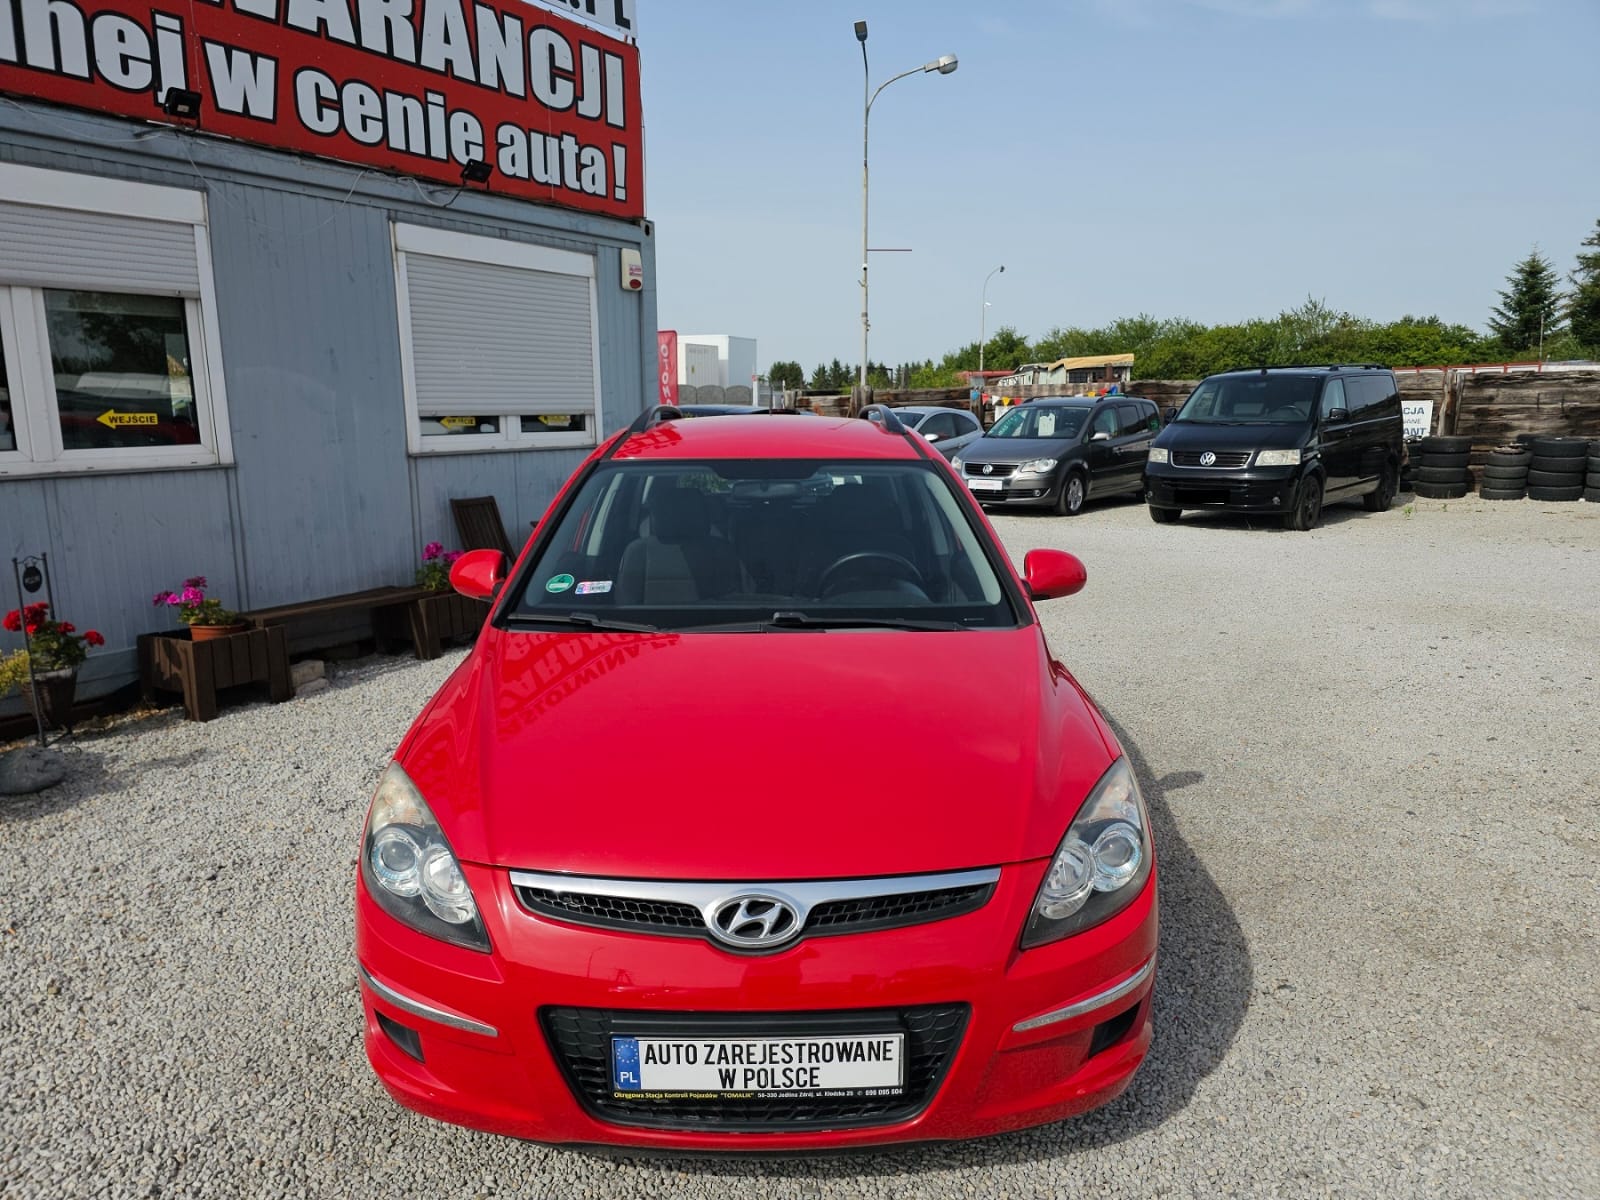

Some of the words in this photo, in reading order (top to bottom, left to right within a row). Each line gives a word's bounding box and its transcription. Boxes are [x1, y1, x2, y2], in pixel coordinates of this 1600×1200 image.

[204, 41, 275, 121] w
[296, 69, 484, 166] cenie
[108, 413, 157, 424] WEJŚCIE
[644, 1043, 698, 1066] AUTO
[703, 1040, 894, 1065] ZAREJESTROWANE
[619, 1071, 639, 1084] PL
[717, 1067, 737, 1090] W
[743, 1066, 821, 1090] POLSCE
